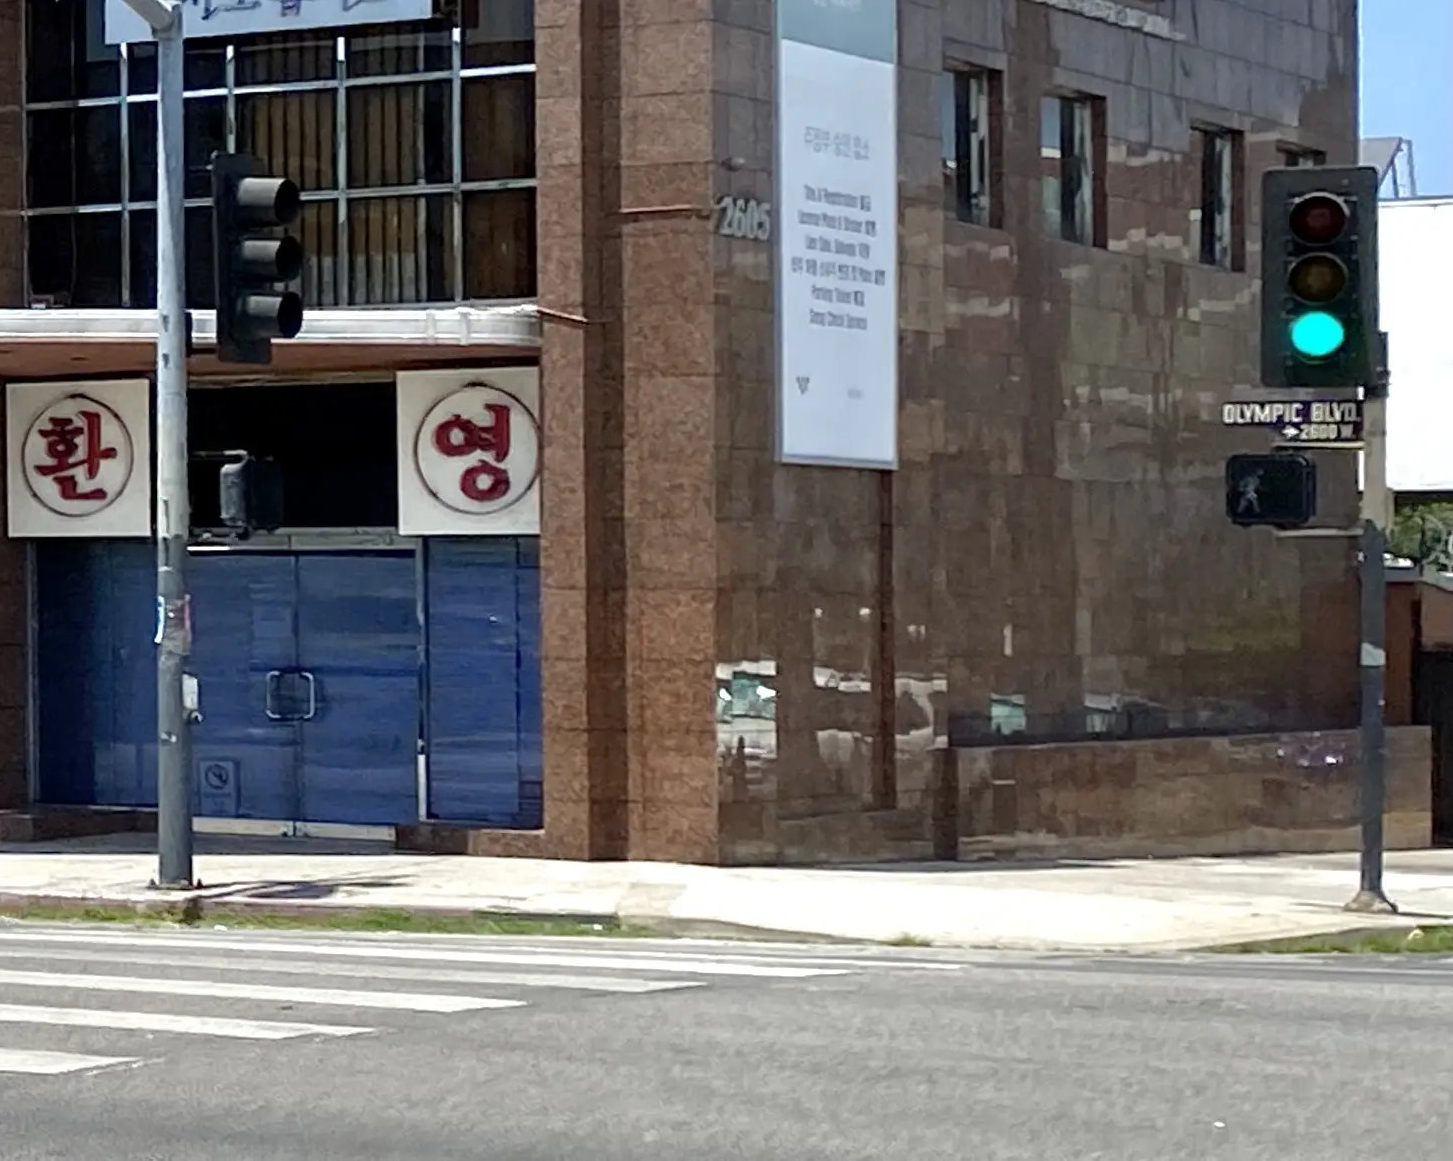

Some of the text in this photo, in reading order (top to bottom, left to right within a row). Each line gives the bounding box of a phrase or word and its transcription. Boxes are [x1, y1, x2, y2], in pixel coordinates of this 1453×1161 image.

[714, 195, 771, 240] 2605
[1223, 403, 1303, 423] OLYMPIC
[1301, 425, 1338, 439] 2600
[34, 411, 117, 500] 환
[432, 404, 510, 501] 영
